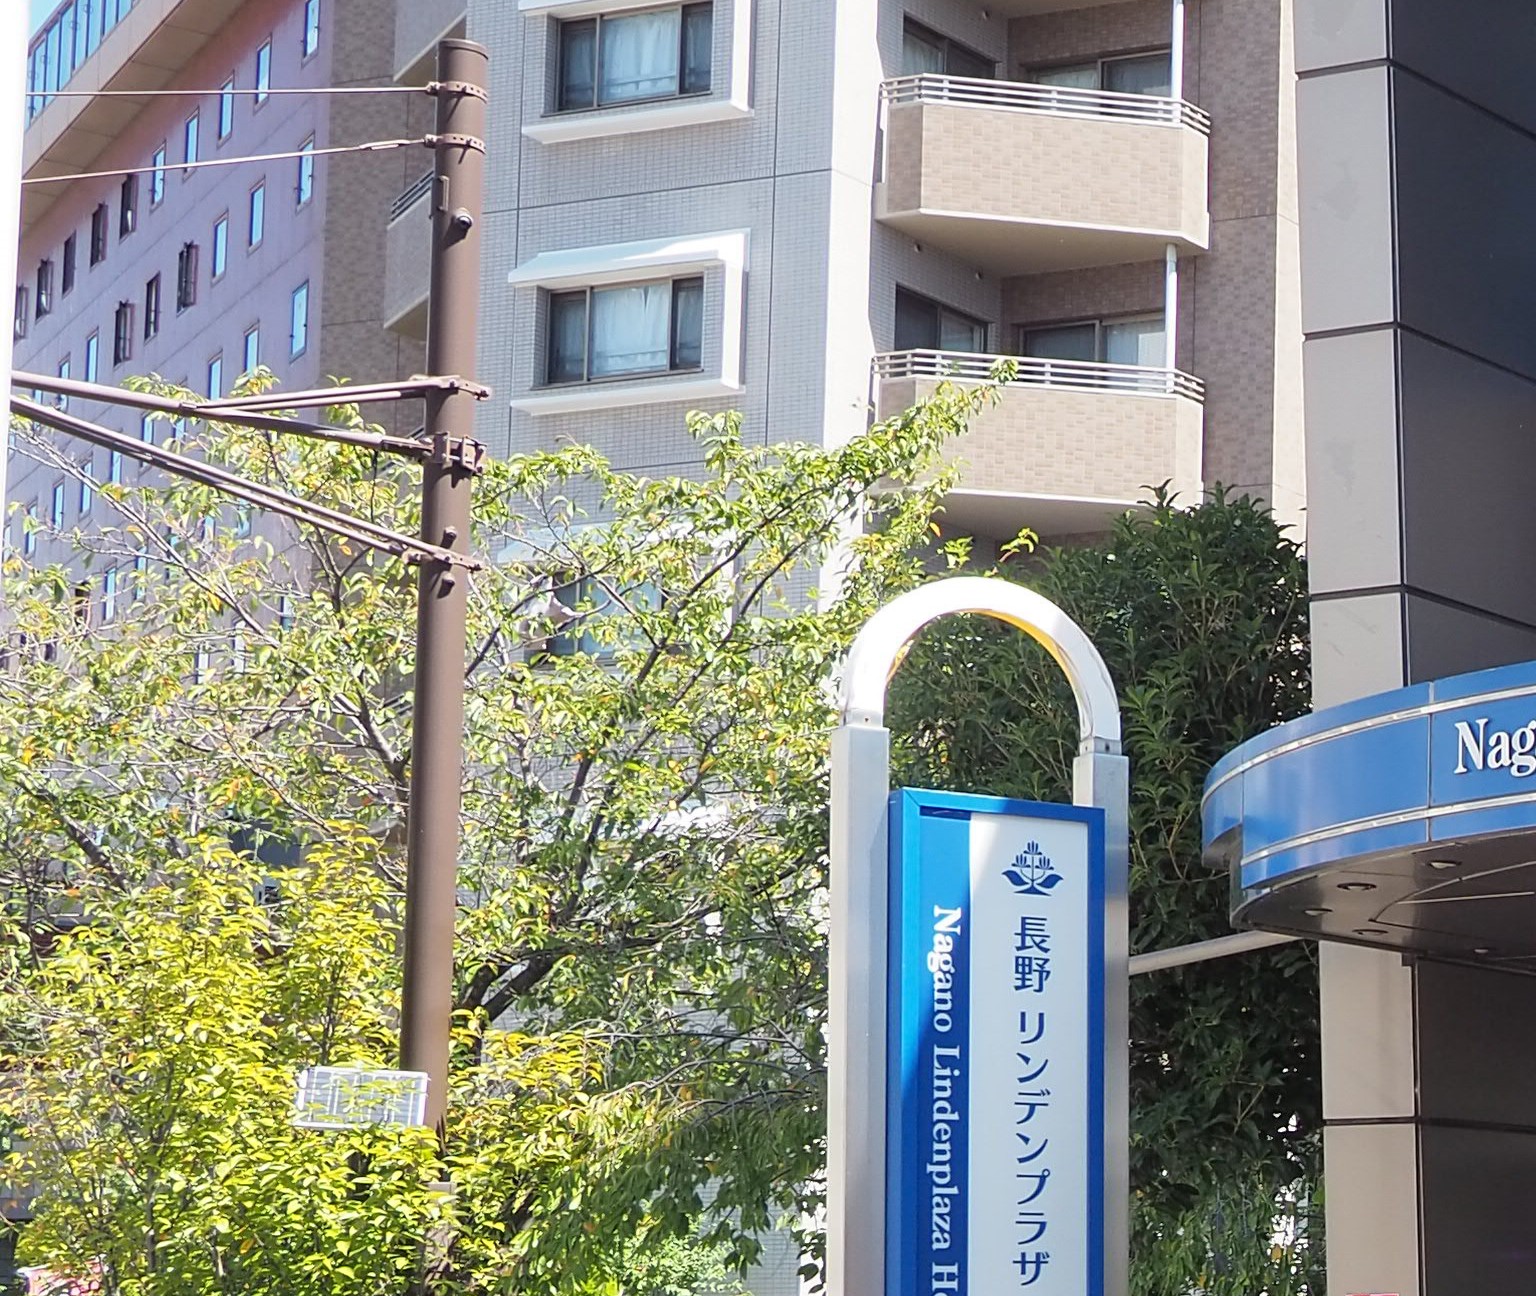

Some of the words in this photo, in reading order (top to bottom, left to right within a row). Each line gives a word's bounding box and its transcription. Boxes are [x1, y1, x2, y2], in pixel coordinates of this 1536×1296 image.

[926, 904, 962, 1033] Nagano
[1013, 916, 1051, 993] 長野
[926, 1044, 961, 1251] Lindenplaza
[1013, 1011, 1051, 1287] リンデンプラザ
